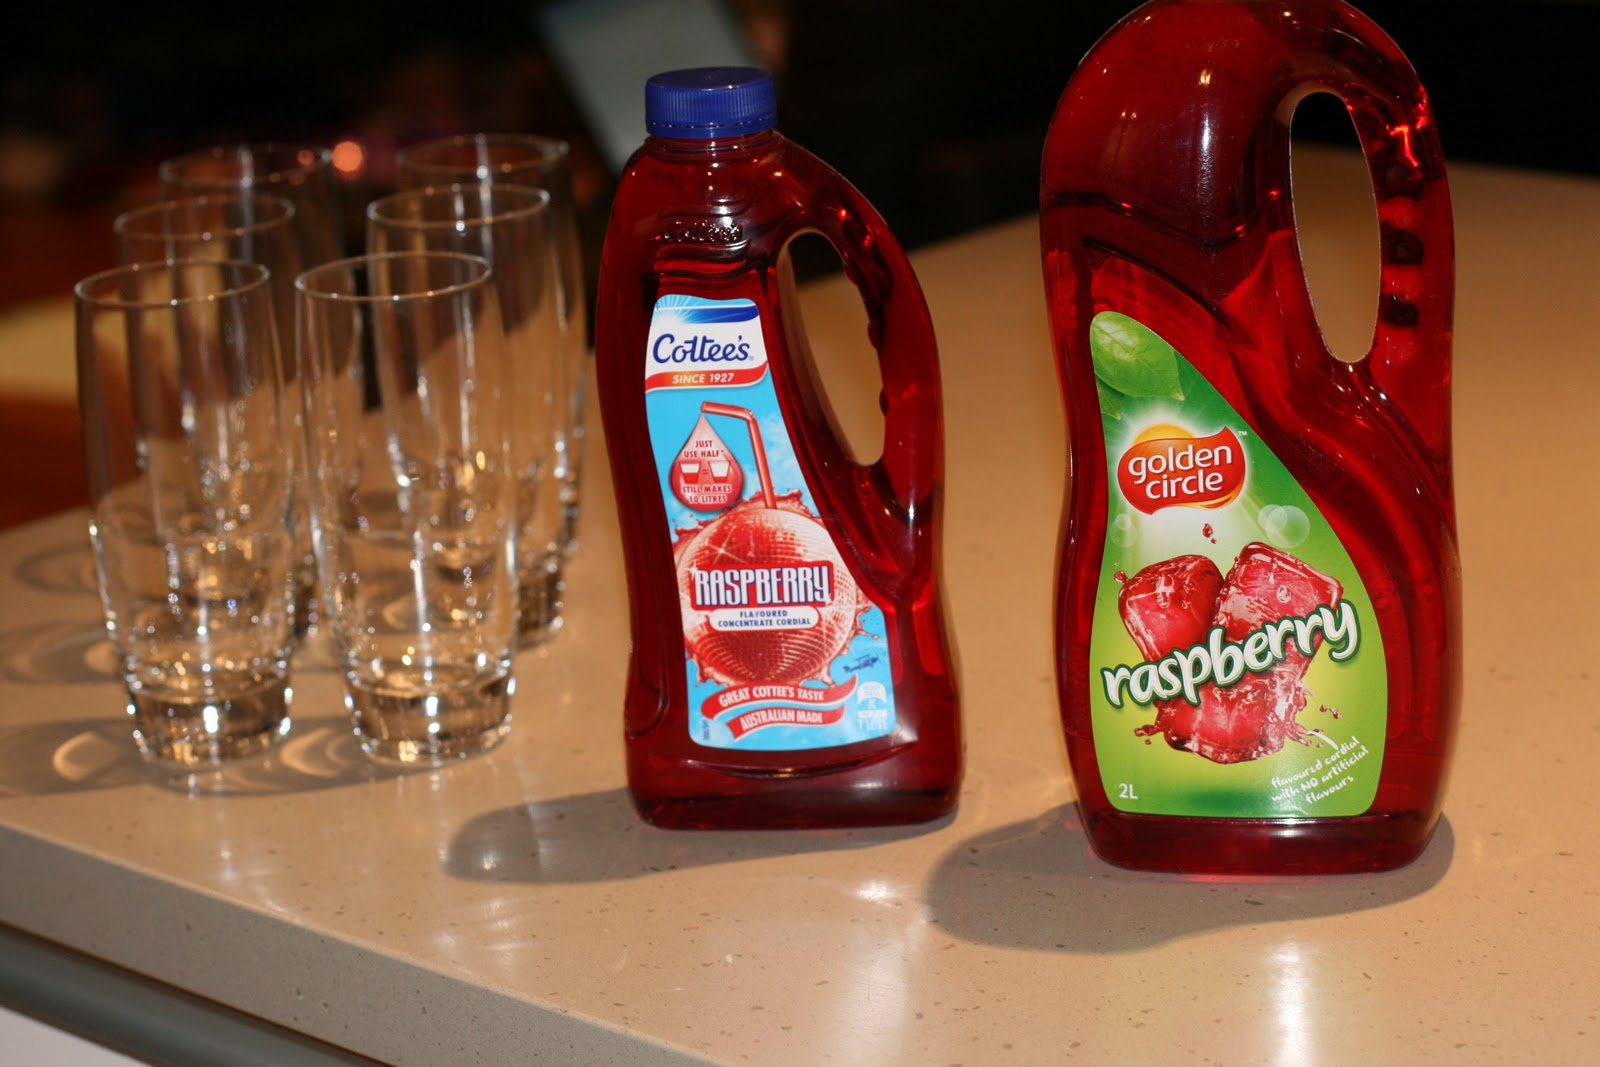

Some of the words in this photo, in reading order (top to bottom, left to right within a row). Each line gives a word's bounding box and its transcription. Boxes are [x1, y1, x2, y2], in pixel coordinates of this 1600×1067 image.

[653, 333, 750, 363] Cottee's
[672, 373, 706, 384] SINCE
[709, 372, 735, 383] 1927
[695, 440, 712, 448] JUST
[1128, 444, 1232, 484] golden
[1145, 469, 1223, 499] circle
[689, 495, 699, 503] 10
[701, 495, 727, 503] LITRES
[694, 565, 830, 606] RASPBERRY
[718, 619, 773, 628] CONCENTRATE
[776, 618, 811, 626] CORDIAL
[740, 610, 788, 618] FLAVOURED
[1102, 600, 1360, 707] raspberry
[718, 686, 750, 708] GREAT
[752, 685, 795, 698] COTTEE'S
[797, 687, 824, 701] TASTE
[740, 708, 795, 732] AUSTRALIAN
[797, 710, 823, 724] MADE
[1271, 759, 1323, 788] flavoured
[1324, 735, 1360, 765] cordial
[1272, 786, 1300, 801] with
[1300, 777, 1319, 791] NO
[1322, 745, 1369, 782] artificial
[1118, 783, 1138, 799] 2L
[1305, 775, 1354, 804] flavours
